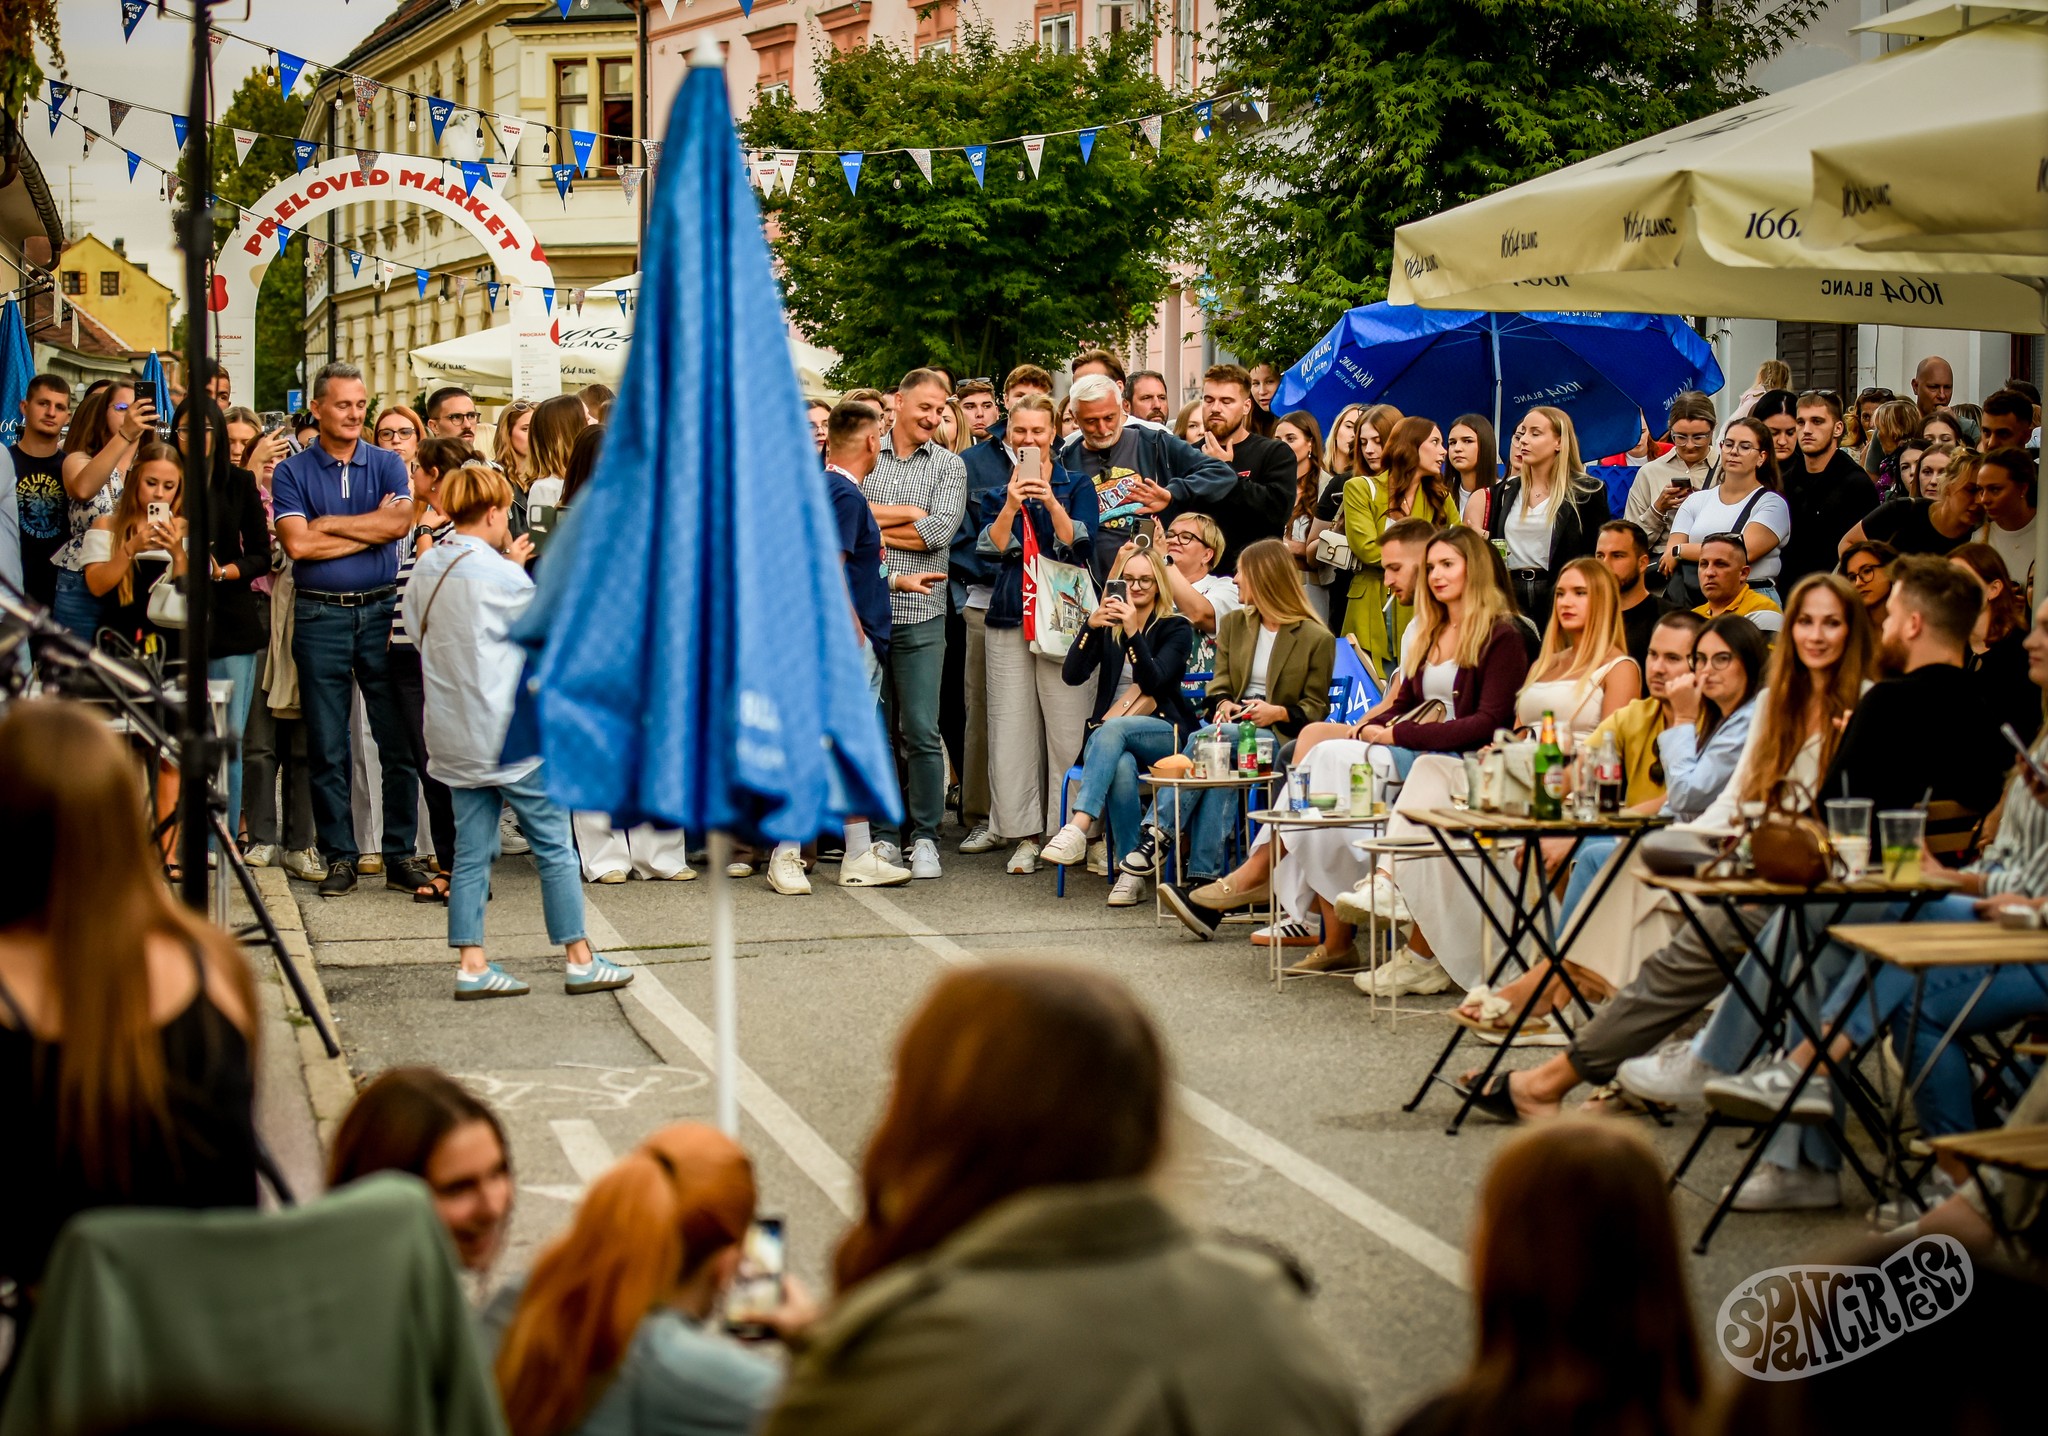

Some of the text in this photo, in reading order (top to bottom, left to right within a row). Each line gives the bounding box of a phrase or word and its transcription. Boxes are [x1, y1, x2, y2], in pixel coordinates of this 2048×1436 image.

[243, 169, 520, 256] PRELOVED MARKET
[1645, 217, 1677, 238] BLANC
[1745, 208, 1802, 239] 166
[1501, 228, 1538, 258] 1664 BLANC
[559, 340, 618, 350] BLANC
